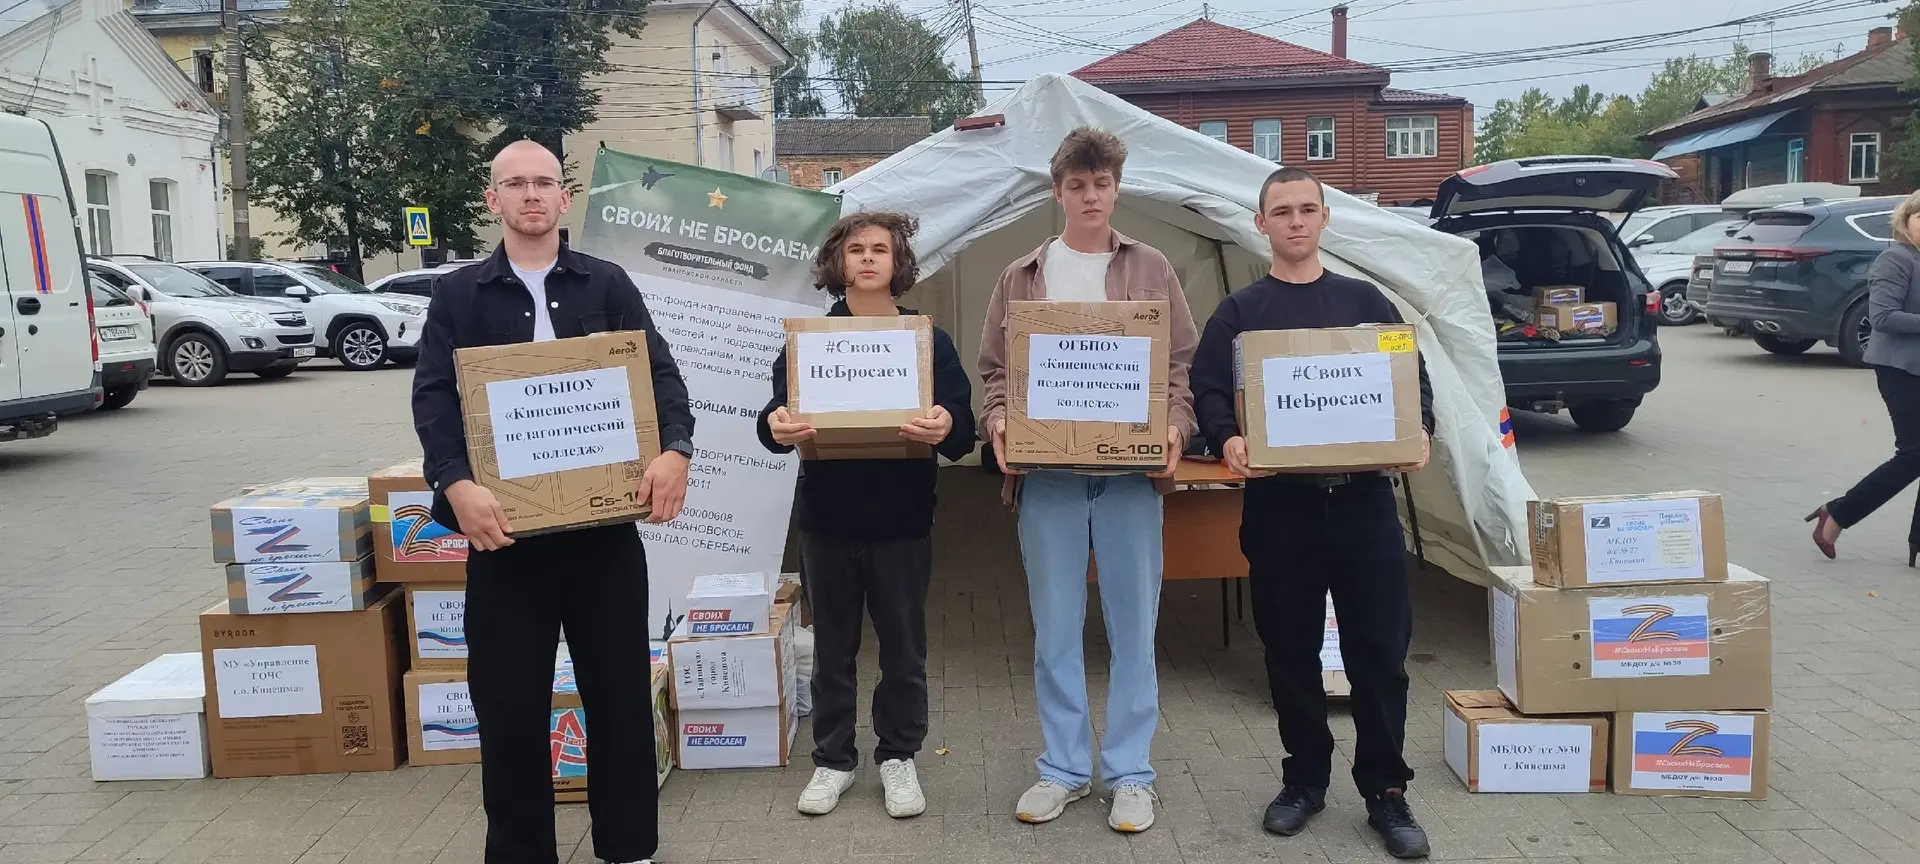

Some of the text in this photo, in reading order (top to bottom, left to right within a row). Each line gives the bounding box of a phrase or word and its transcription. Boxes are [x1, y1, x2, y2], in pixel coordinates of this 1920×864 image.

[601, 204, 820, 263] СВОИХ НЕ БРОСАЕМ
[657, 246, 754, 275] БЛАГОТВОРИТЕЛЬНЫЙ ФОНД
[662, 265, 744, 287] ИВАНОВСКОЙ ОБЛАСТИ
[664, 295, 699, 309] фонда
[700, 304, 762, 321] направлена
[764, 316, 776, 324] на
[689, 315, 731, 331] помощи
[668, 326, 704, 340] частей
[711, 335, 718, 343] и
[826, 340, 891, 354] #Своих
[1059, 340, 1122, 351] ОГБПОУ
[675, 343, 736, 362] гражданам,
[739, 355, 752, 364] их
[753, 358, 773, 369] род
[690, 361, 732, 376] помощь
[1040, 358, 1139, 372] «Кинешемский
[1292, 364, 1363, 381] #Своих
[810, 364, 908, 382] НеБросаем
[524, 378, 597, 396] ОГБПОУ
[1037, 379, 1140, 391] педагогический
[505, 397, 621, 421] «Кинешемский
[1057, 399, 1119, 409] колледж»
[1276, 392, 1383, 412] НеБросаем
[506, 418, 625, 442] педагогический
[532, 446, 604, 461] колледж»
[1096, 444, 1163, 455] Cs-100
[590, 490, 639, 508] Cs-1
[667, 520, 745, 540] ИВАНОВСКОЕ
[664, 533, 689, 546] ПАО
[691, 538, 752, 555] СБЕРБАНК
[439, 600, 466, 609] СВО
[693, 611, 724, 620] СВОИХ
[696, 623, 750, 632] НЕ БРОСАЕМ
[1614, 646, 1688, 655] #СвоихНеБросаем
[223, 658, 309, 669] МУ «Управление
[1620, 660, 1648, 668] МБДОУ
[252, 670, 283, 681] ГОЧС
[682, 665, 692, 686] ТОС
[710, 660, 718, 685] город
[721, 651, 730, 693] Кинешма
[251, 685, 304, 694] Кинешма»
[687, 725, 717, 734] СВОИХ
[691, 736, 743, 746] НЕ БРОСАЕМ
[1490, 744, 1580, 756] МБДОУ д/с №30
[1515, 762, 1566, 770] Кинешма
[1655, 759, 1731, 769] #СвоихНеБросаем
